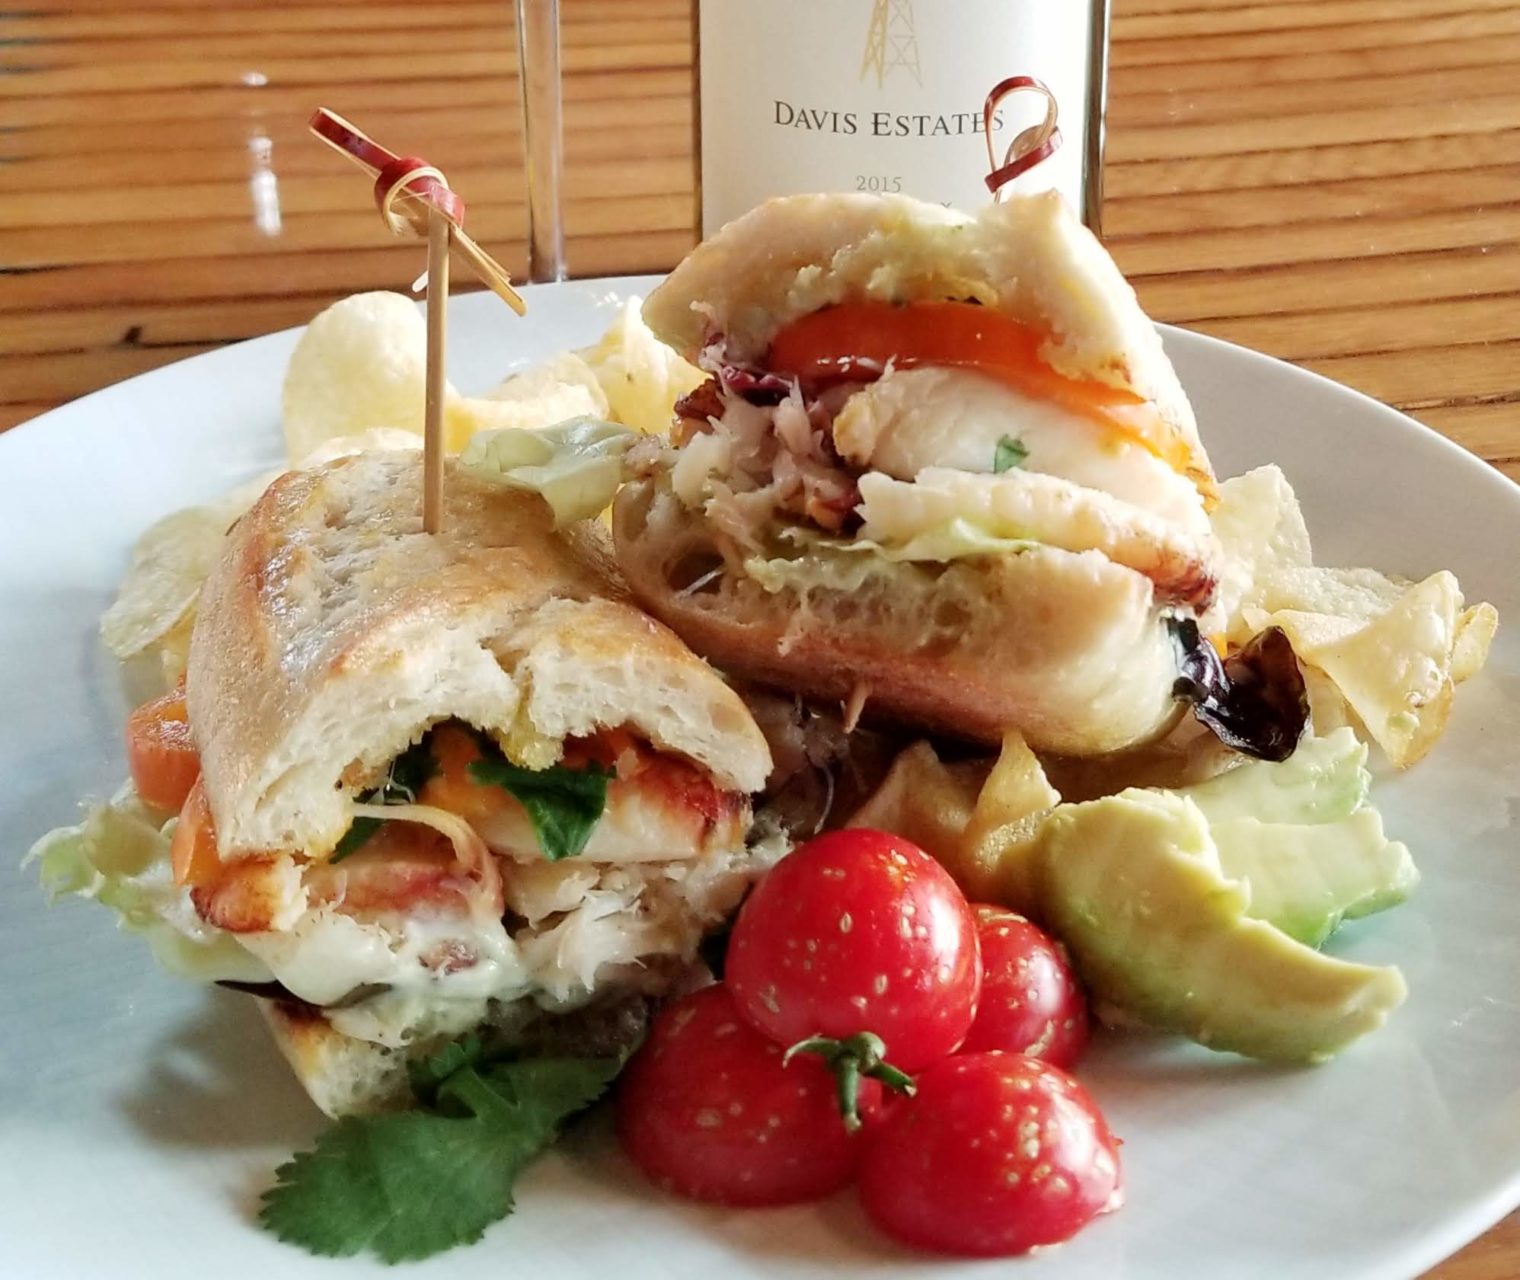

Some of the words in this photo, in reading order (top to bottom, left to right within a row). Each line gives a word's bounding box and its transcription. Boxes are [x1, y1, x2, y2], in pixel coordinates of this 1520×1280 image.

[773, 100, 857, 135] DAVIS
[871, 110, 1004, 137] ESTATES
[856, 175, 902, 193] 2015
